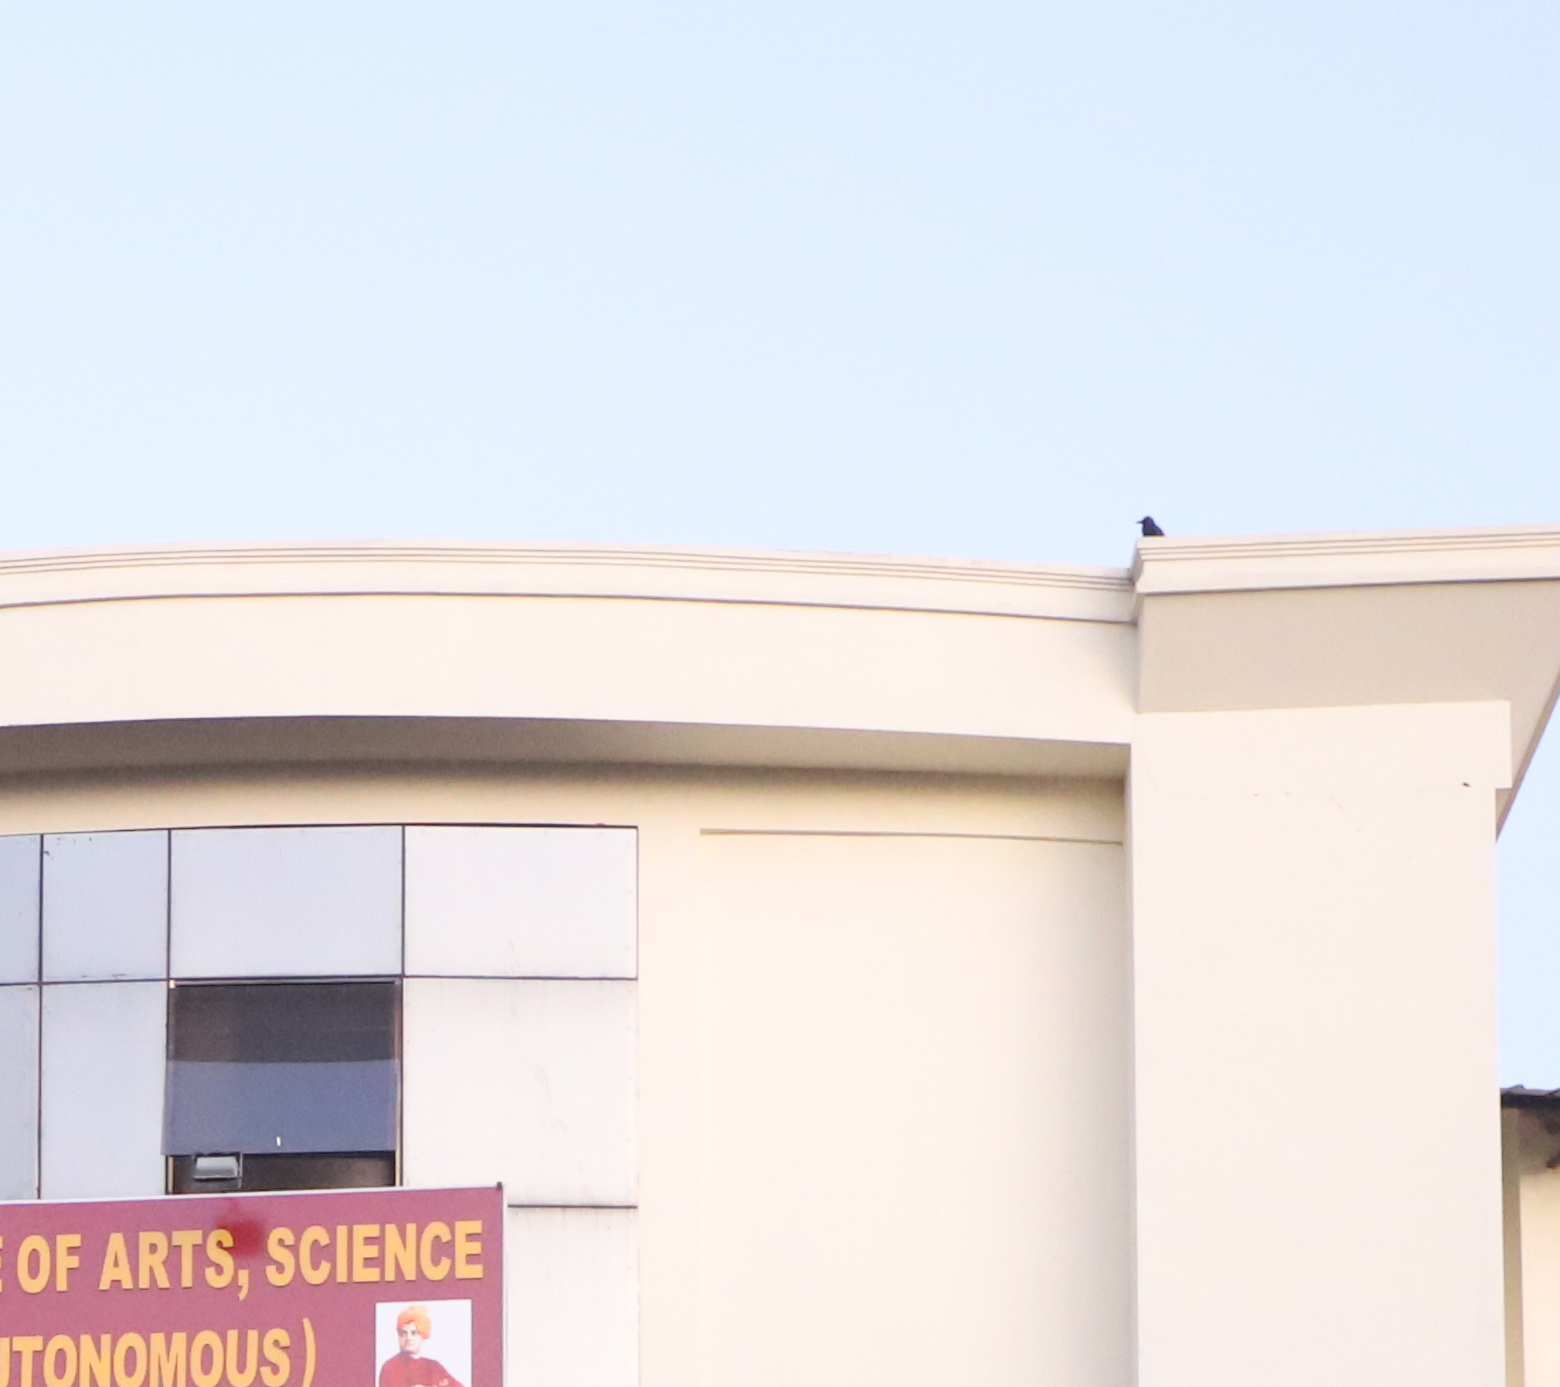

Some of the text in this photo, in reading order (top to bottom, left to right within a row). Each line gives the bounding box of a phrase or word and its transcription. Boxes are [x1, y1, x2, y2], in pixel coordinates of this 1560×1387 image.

[16, 1233, 82, 1294] OF
[98, 1229, 251, 1301] ARTS,
[264, 1218, 487, 1287] SCIENCE
